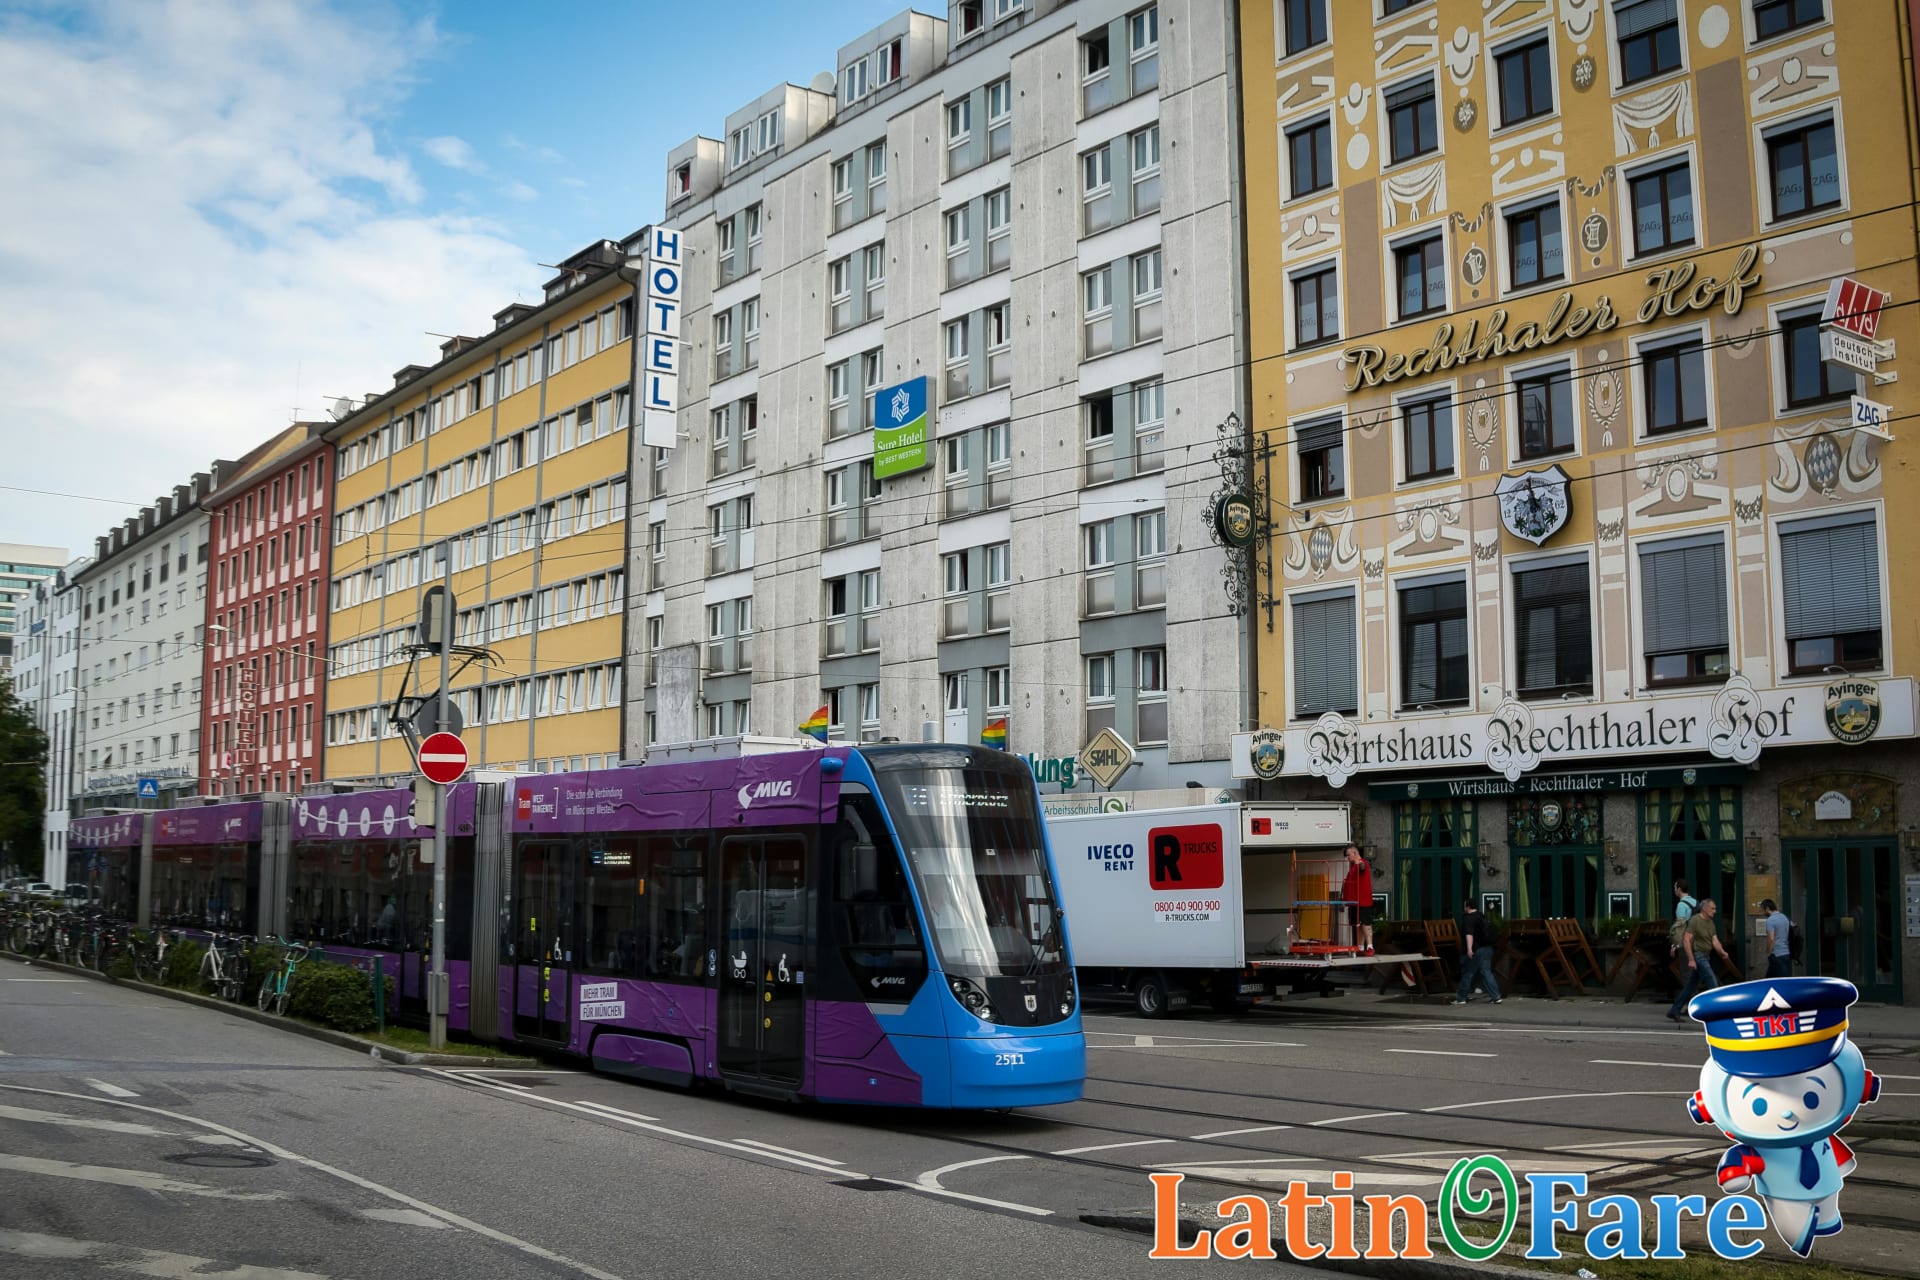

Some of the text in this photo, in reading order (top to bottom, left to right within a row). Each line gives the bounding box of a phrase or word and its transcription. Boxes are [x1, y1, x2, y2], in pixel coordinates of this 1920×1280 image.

[653, 229, 678, 407] HOTEL
[1343, 243, 1761, 394] Rechthaler Hof
[1834, 336, 1874, 358] deutsch
[1834, 347, 1875, 370] institut
[1857, 402, 1880, 427] ZAG
[878, 428, 923, 455] Sure Hotel
[885, 453, 898, 465] BEST
[899, 448, 922, 460] WESTERN
[1826, 681, 1876, 700] Ayinger
[242, 671, 253, 762] HOTEL
[1252, 731, 1283, 745] Ayinger
[1309, 696, 1796, 766] Wirtshaus Rechthaler Hof
[1090, 748, 1120, 767] STAHL
[753, 780, 792, 798] MVG
[1448, 780, 1516, 797] Wirtshaus
[1530, 774, 1605, 793] Rechthaler
[1620, 770, 1648, 788] Hof
[518, 797, 531, 809] Tram
[1044, 803, 1099, 816] Arbeitsschuhe
[1088, 844, 1134, 860] IVECO
[1154, 835, 1217, 882] R TRUCKS
[1104, 861, 1134, 872] RENT
[1154, 900, 1221, 913] 0800 40 900 900
[1165, 913, 1210, 923] R-TRUCKS.COM
[881, 976, 906, 985] MVG
[584, 986, 614, 1000] MEHR TRAM
[583, 1004, 622, 1018] FÜR MÜNCHEN
[995, 1054, 1025, 1066] 2511
